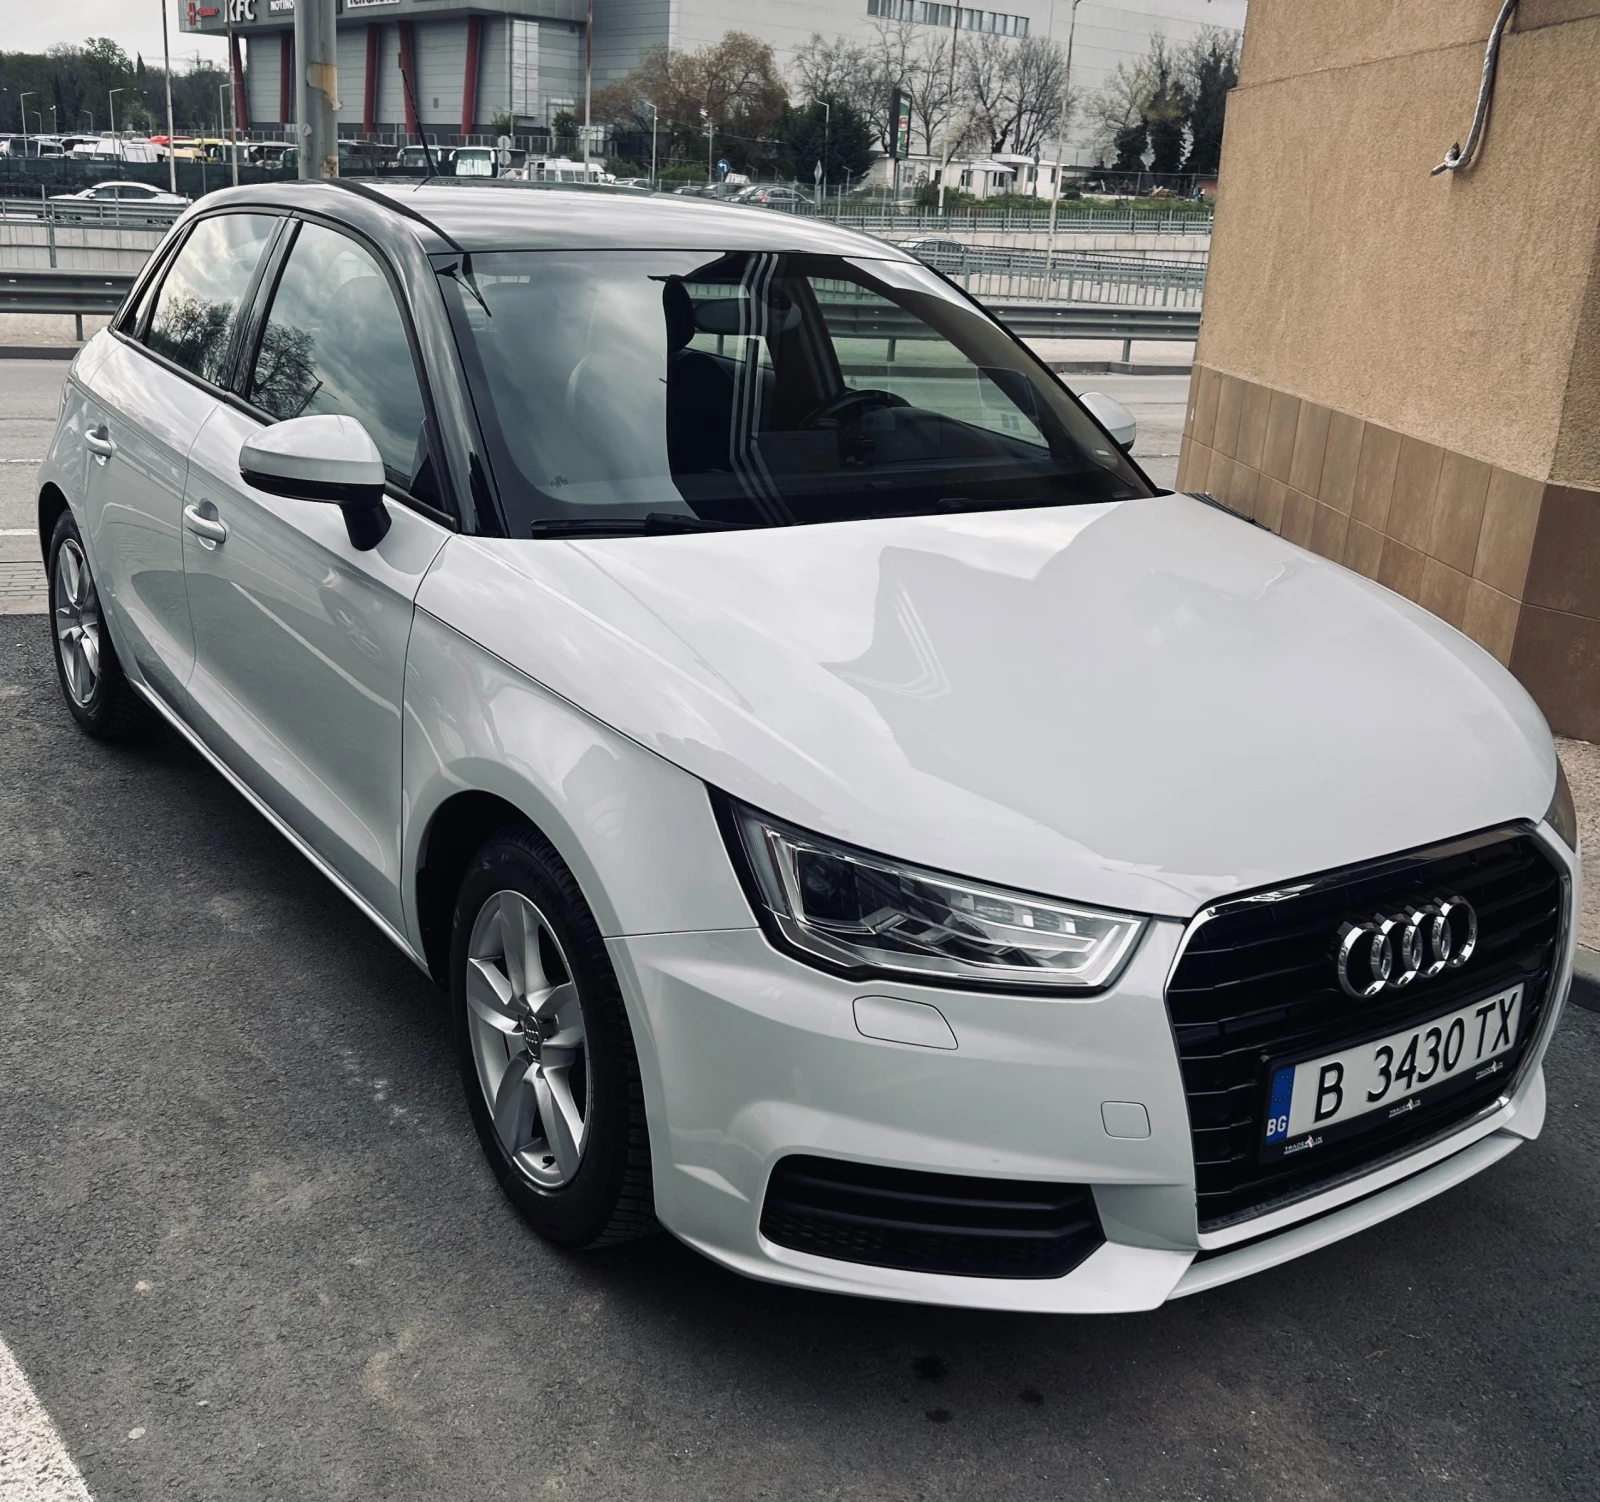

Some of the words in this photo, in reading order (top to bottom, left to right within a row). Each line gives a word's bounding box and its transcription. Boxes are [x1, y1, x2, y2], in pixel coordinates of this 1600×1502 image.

[223, 0, 255, 22] KFC
[270, 0, 294, 11] NOTINO
[1314, 1061, 1345, 1123] B
[1367, 1017, 1465, 1103] 3430
[1475, 991, 1518, 1060] TX
[1266, 1117, 1287, 1137] BG
